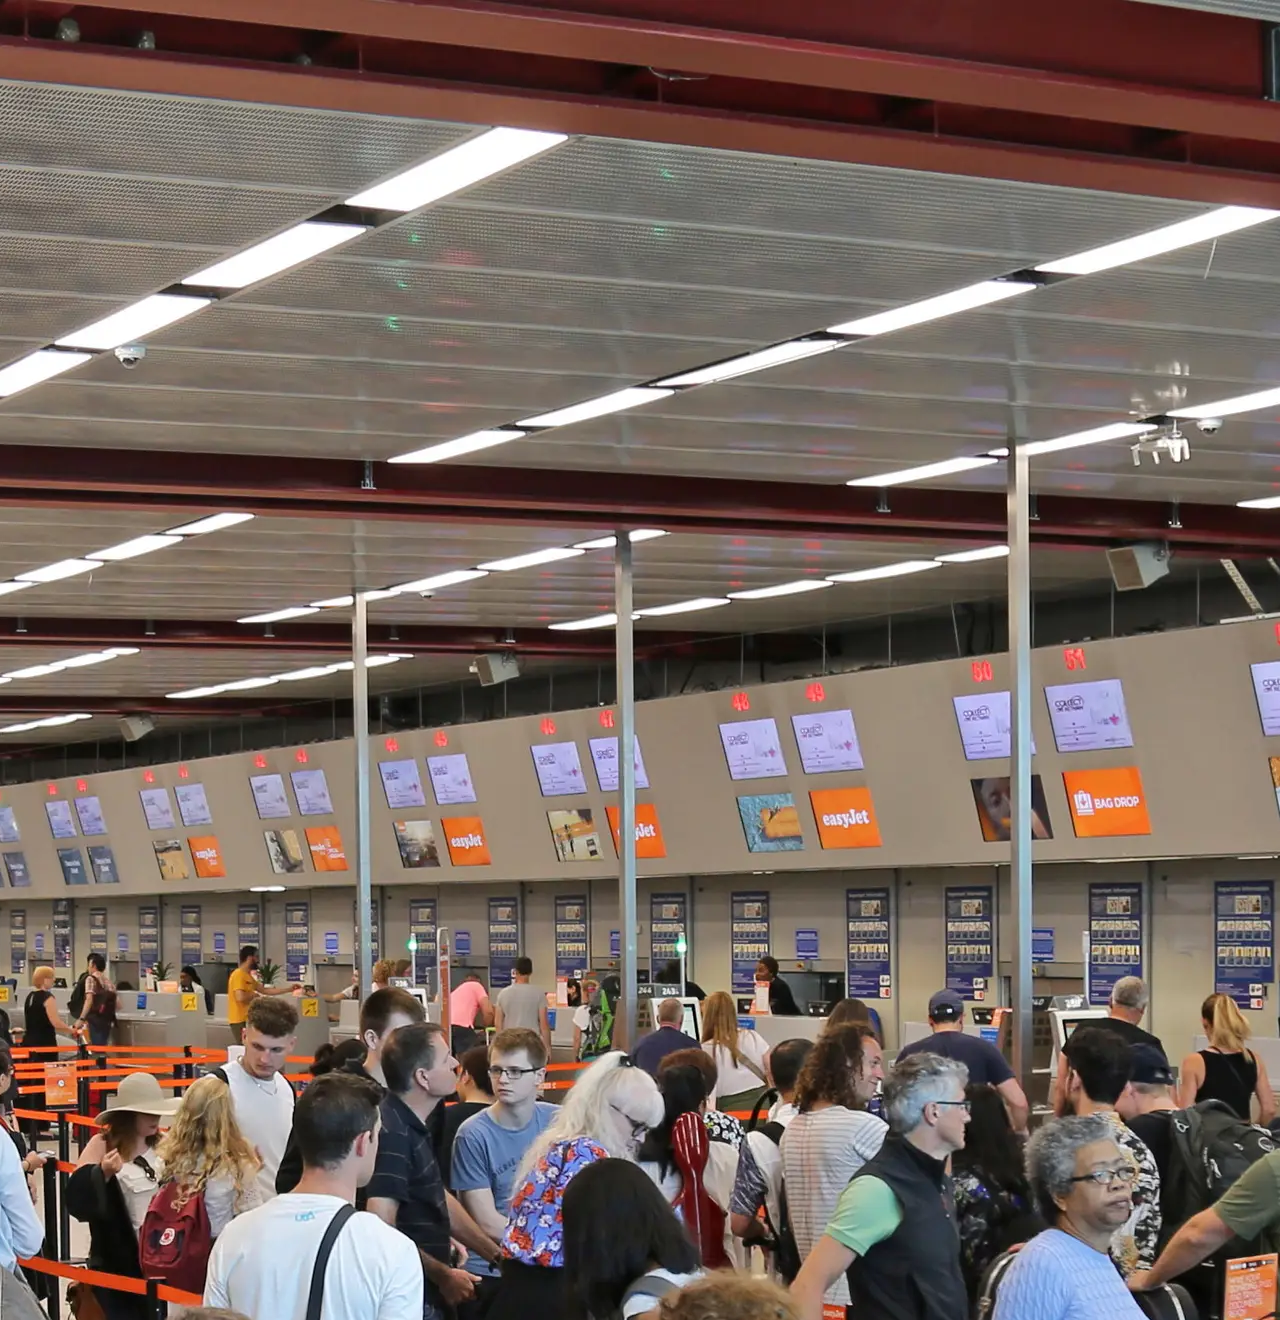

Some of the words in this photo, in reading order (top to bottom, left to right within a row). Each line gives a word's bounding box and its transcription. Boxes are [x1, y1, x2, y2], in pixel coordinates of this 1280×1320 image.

[1063, 648, 1086, 671] 51
[972, 660, 993, 682] 50
[805, 682, 825, 702] 49
[1095, 798, 1112, 808] BAG
[1114, 796, 1139, 807] DROP
[822, 809, 870, 828] easyJet
[451, 834, 483, 849] easyJet
